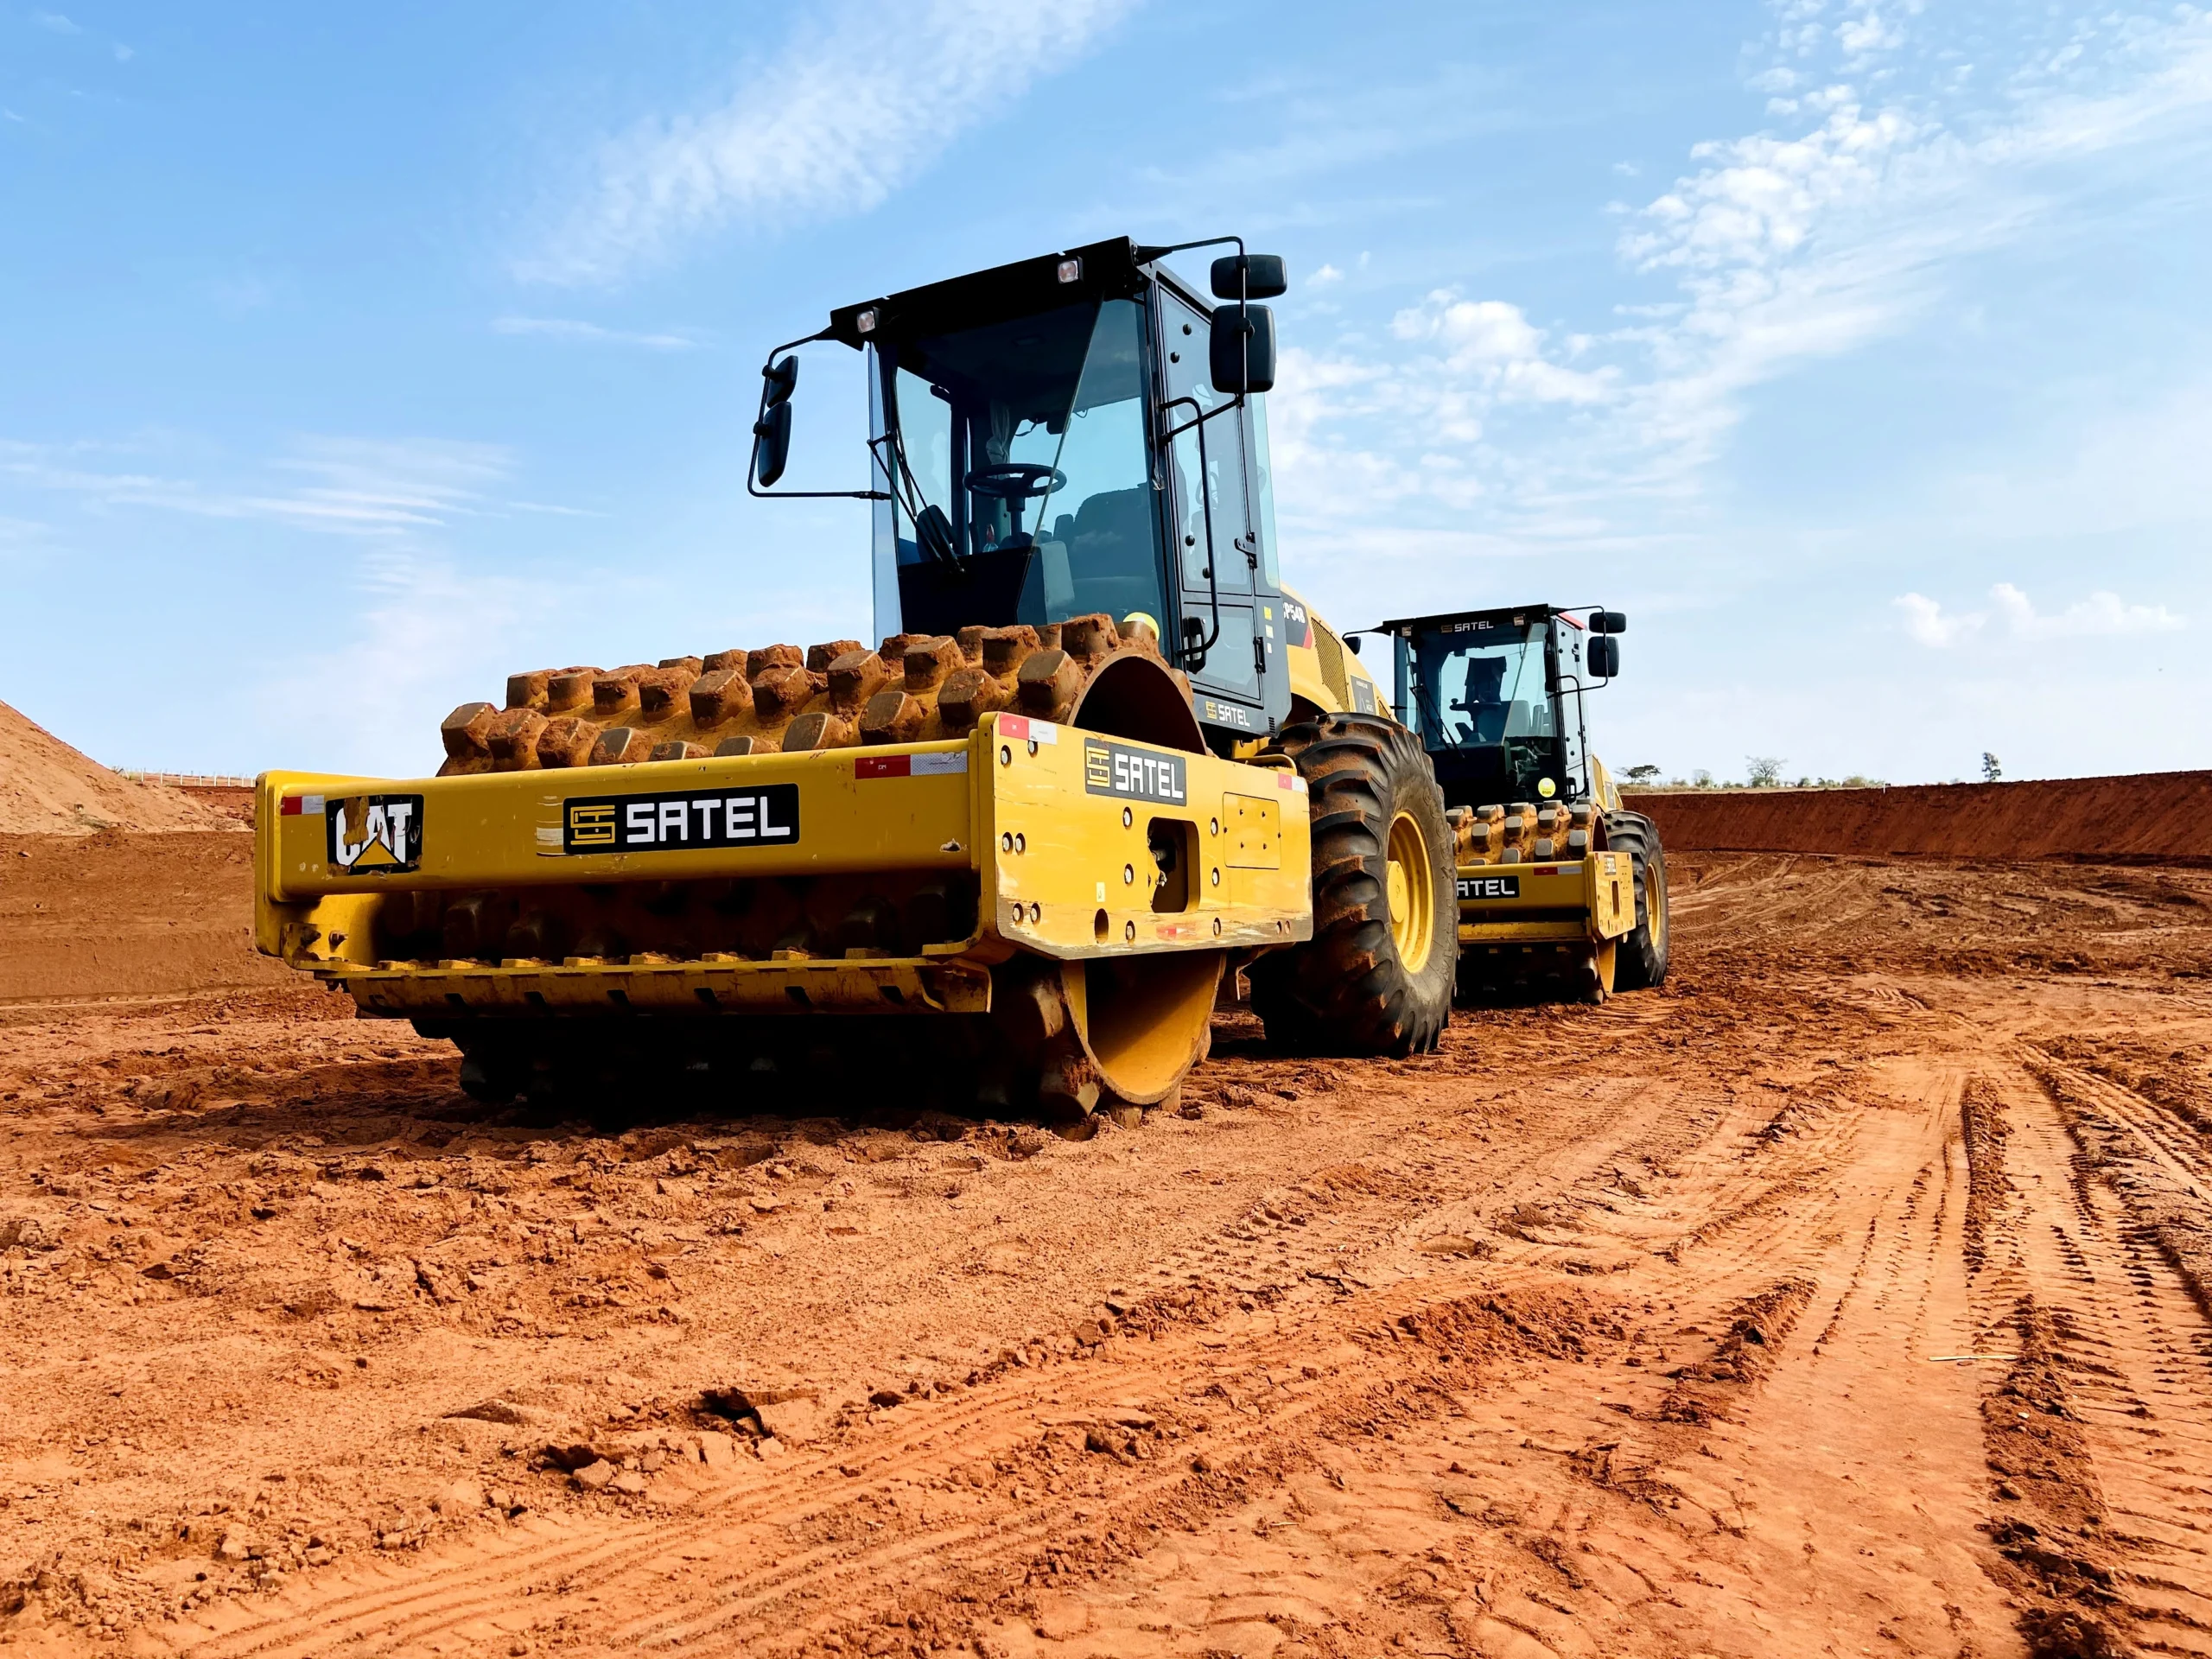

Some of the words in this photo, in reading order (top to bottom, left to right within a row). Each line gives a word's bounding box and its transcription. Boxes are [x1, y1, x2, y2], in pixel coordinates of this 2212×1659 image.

[1454, 620, 1494, 632] SATEL
[1218, 703, 1250, 728] SATEL
[1115, 753, 1184, 799] SATEL
[626, 796, 791, 843] SATEL
[1456, 879, 1516, 897] ATEL
